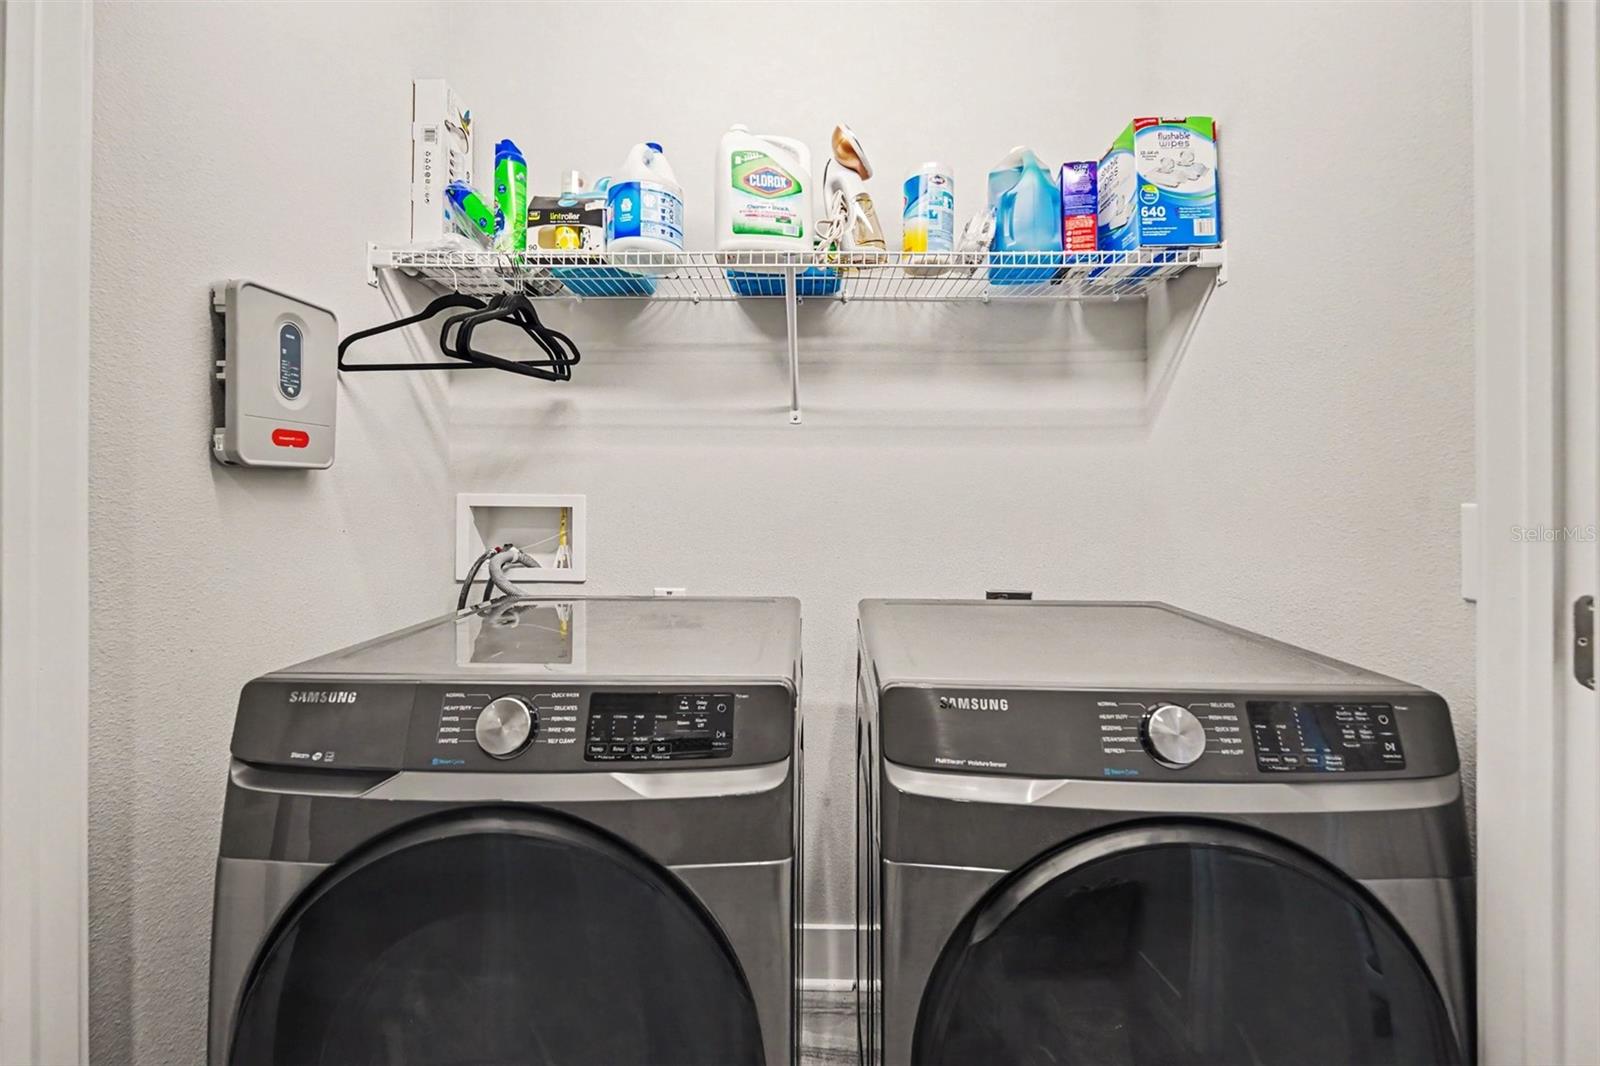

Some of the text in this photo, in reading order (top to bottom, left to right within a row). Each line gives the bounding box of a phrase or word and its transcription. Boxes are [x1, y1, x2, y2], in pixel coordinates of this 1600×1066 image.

[1157, 131, 1190, 140] flushable
[1158, 140, 1190, 149] wipes
[748, 174, 787, 188] CLOROX
[1141, 206, 1166, 217] 640
[289, 691, 357, 704] SAMSUNG
[940, 696, 1009, 711] SAMSUNG
